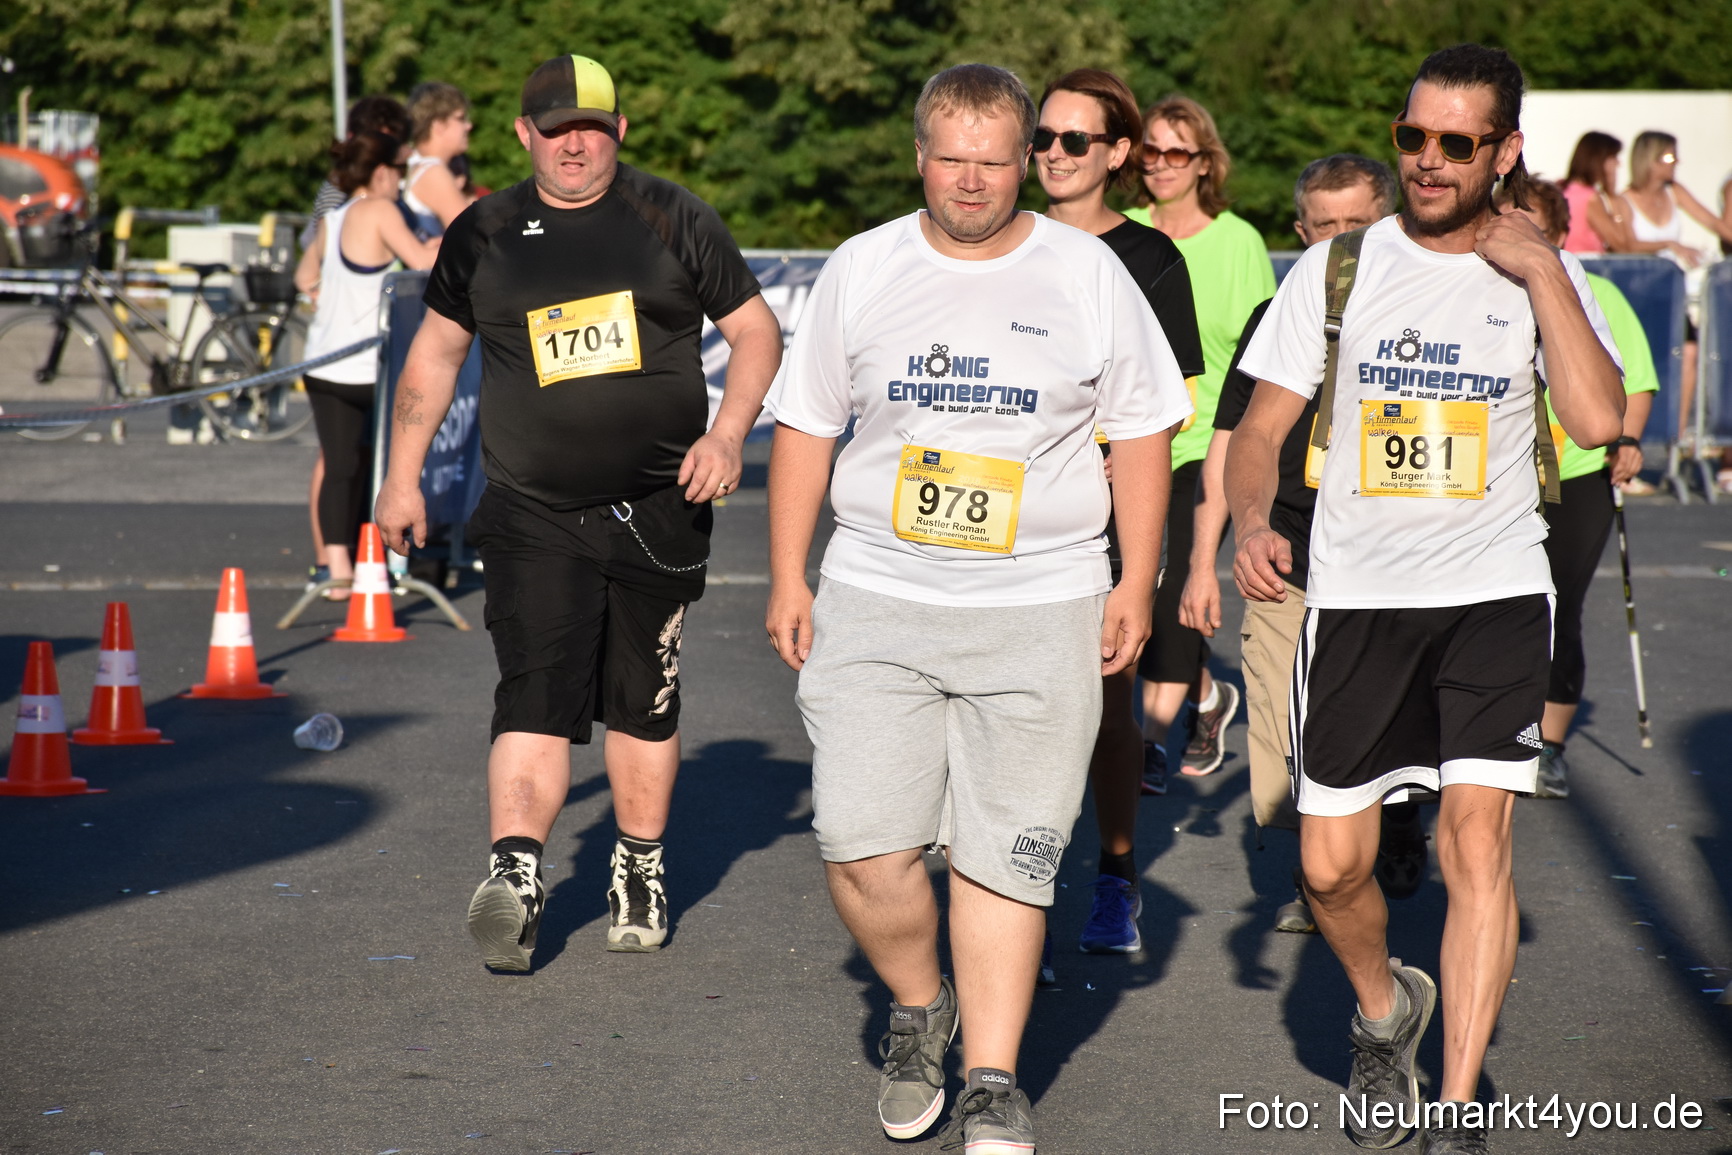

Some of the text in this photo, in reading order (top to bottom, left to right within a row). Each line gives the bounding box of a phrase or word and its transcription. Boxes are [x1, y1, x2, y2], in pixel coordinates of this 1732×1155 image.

[1486, 314, 1509, 328] Sam
[1011, 322, 1049, 337] Roman
[545, 321, 624, 360] 1704
[563, 352, 610, 366] Gut Norbert
[1358, 362, 1511, 399] Engineering
[887, 380, 1039, 413] Engineering
[1400, 389, 1413, 397] we
[1416, 391, 1438, 400] build
[1440, 393, 1463, 402] your
[932, 404, 1019, 417] we build your tools
[1376, 416, 1418, 424] firmenlauf
[1385, 435, 1453, 471] 981
[914, 461, 955, 474] firmenlauf
[1391, 472, 1451, 482] Burger Mark
[1400, 482, 1439, 490] Engineering
[918, 482, 990, 524] 978
[916, 516, 986, 534] Rustler Roman
[910, 526, 928, 536] König
[929, 528, 968, 540] Engineering
[969, 534, 990, 542] GmbH
[1516, 735, 1543, 750] adidas
[1011, 833, 1062, 864] LONSDALE
[982, 1074, 1009, 1084] adidas
